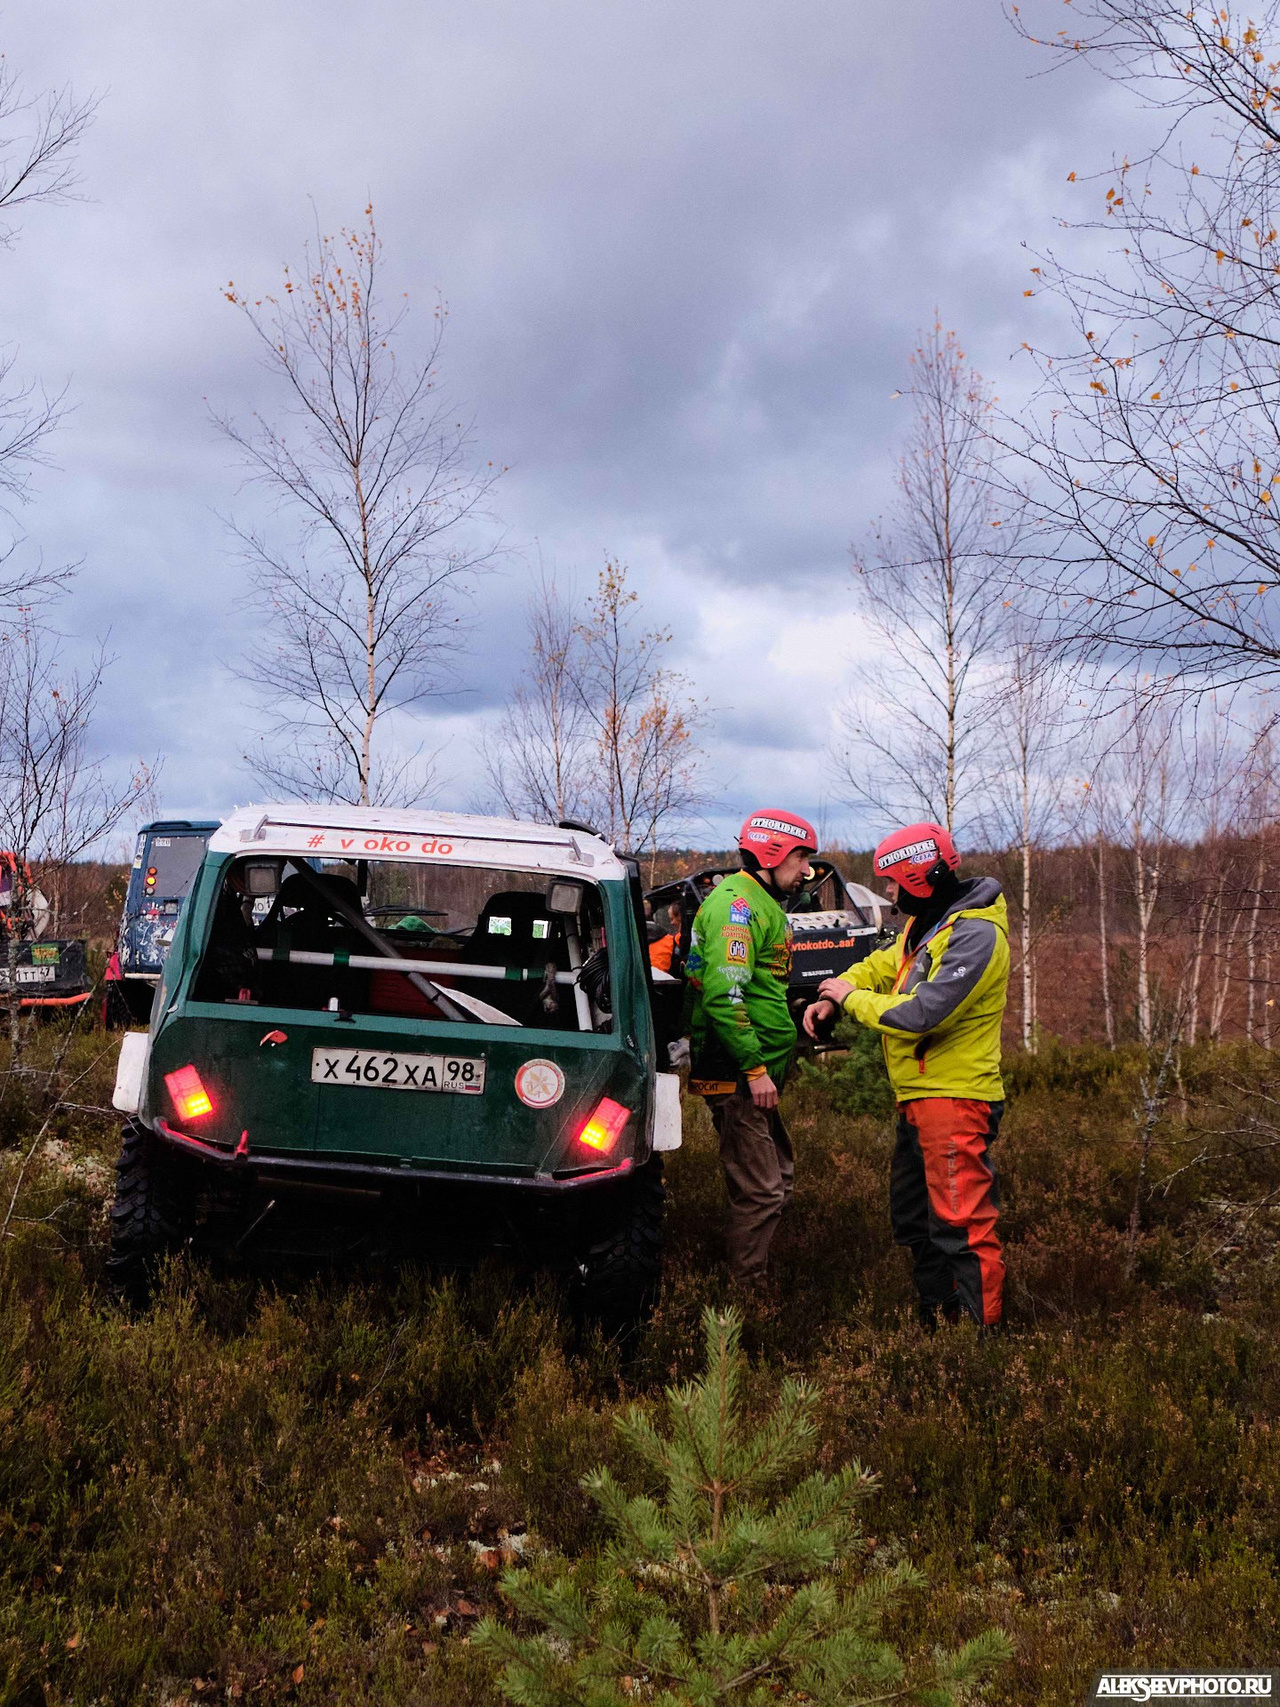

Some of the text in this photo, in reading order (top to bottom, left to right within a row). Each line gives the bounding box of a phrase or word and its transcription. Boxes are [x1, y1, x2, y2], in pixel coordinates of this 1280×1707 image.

[340, 838, 355, 849] v
[364, 837, 410, 852] oko
[421, 840, 453, 855] do
[792, 937, 856, 951] vtokotdoaaf
[447, 1061, 475, 1082] 98
[443, 1081, 465, 1090] RUS
